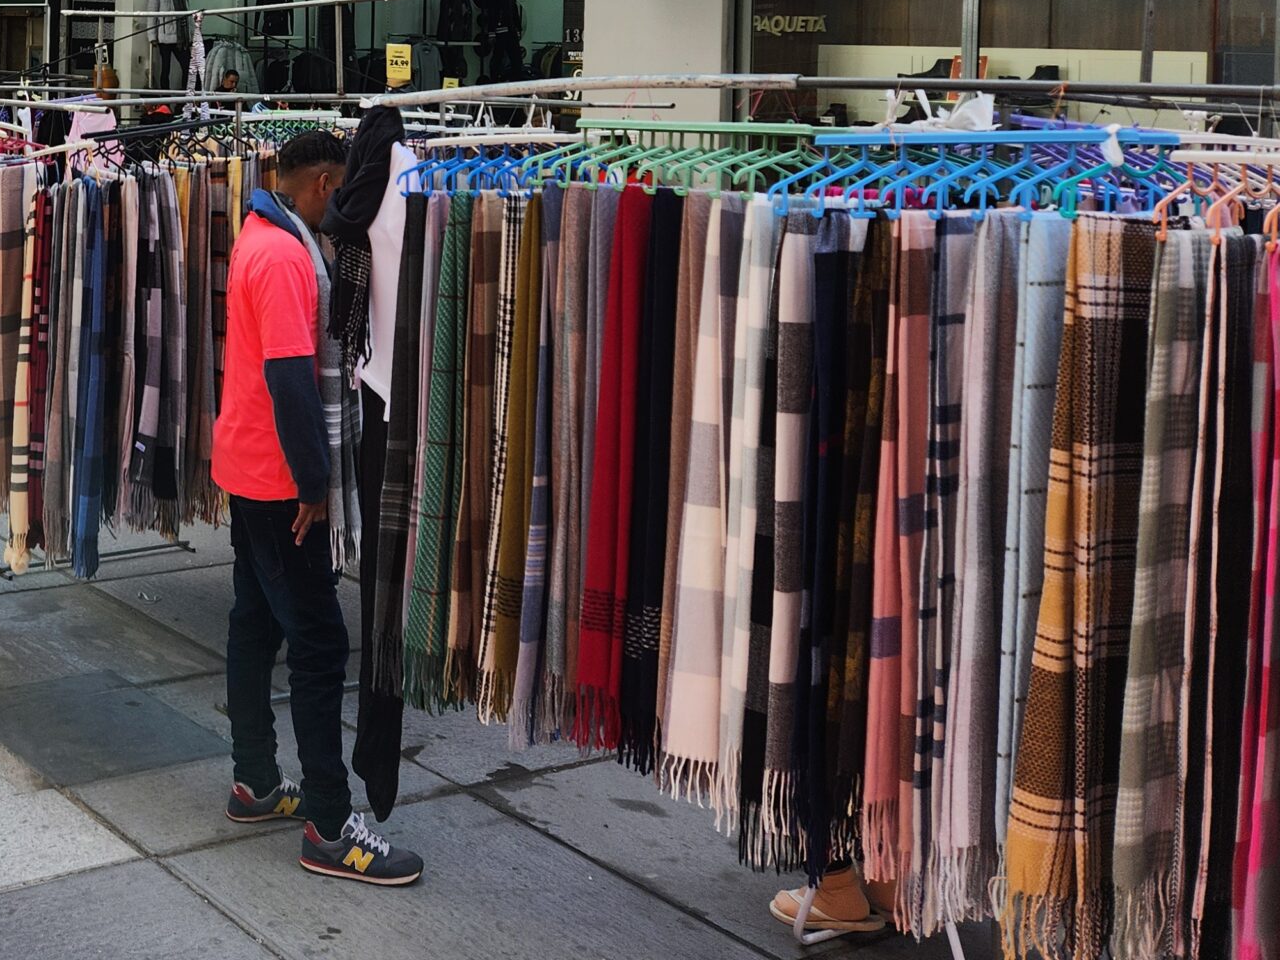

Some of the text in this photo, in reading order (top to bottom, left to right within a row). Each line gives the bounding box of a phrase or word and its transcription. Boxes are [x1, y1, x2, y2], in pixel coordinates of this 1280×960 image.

[564, 28, 584, 43] 13
[753, 14, 827, 36] PAQUETÁ
[273, 796, 301, 816] N
[342, 846, 375, 873] N
